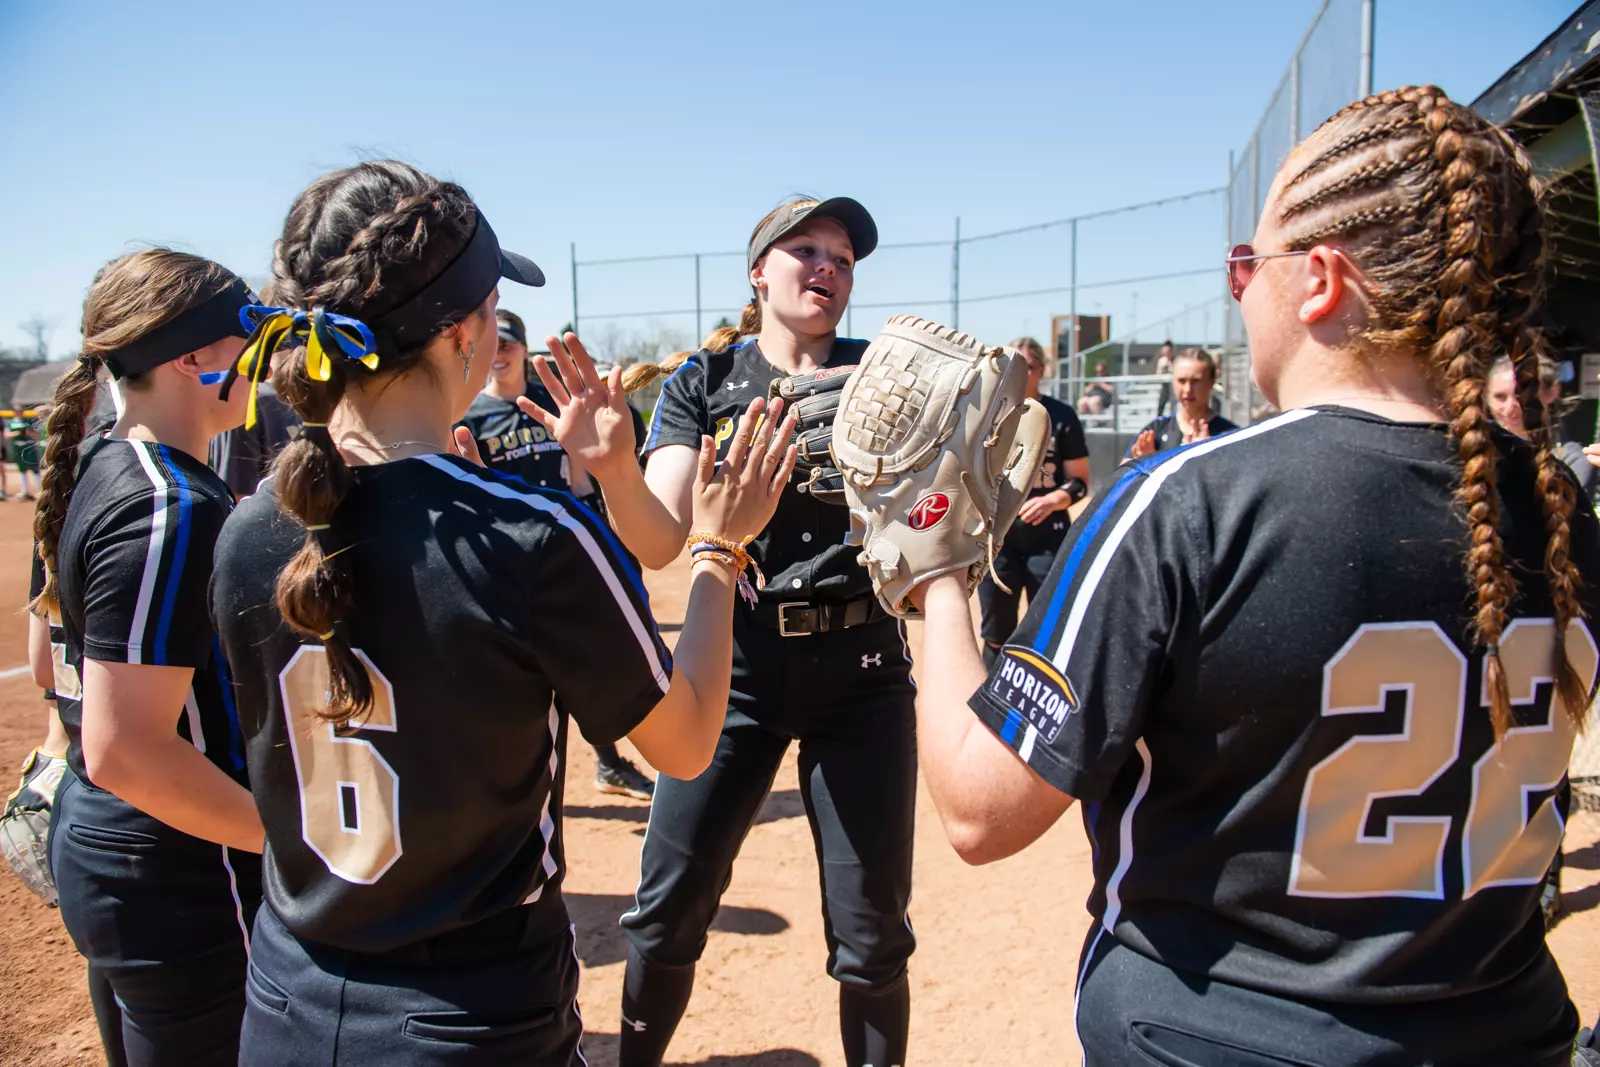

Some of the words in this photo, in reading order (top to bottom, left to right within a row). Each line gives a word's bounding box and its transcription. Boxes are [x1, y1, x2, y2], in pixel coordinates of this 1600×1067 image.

[279, 644, 403, 885] 6
[993, 680, 1058, 740] LEAGUE
[1001, 658, 1070, 725] HORIZON
[1287, 617, 1599, 900] 22
